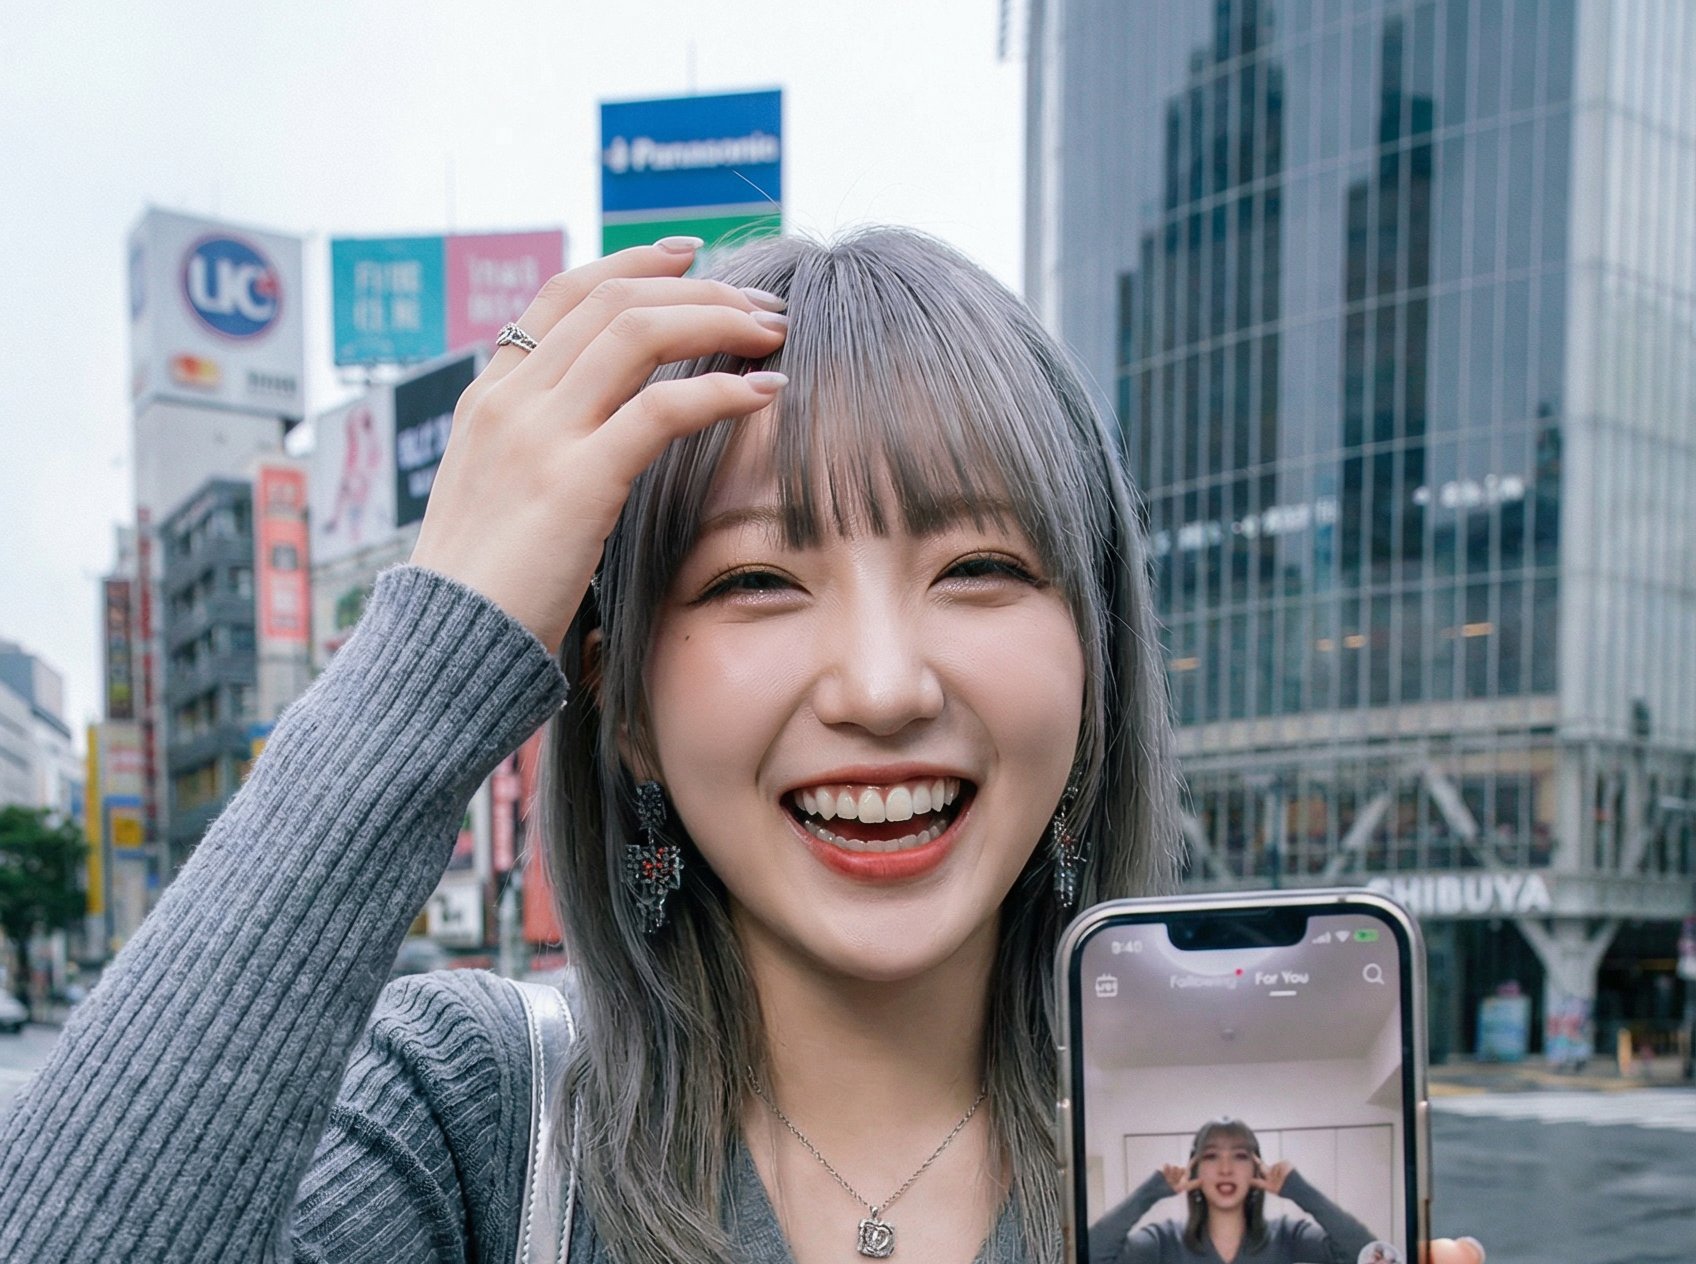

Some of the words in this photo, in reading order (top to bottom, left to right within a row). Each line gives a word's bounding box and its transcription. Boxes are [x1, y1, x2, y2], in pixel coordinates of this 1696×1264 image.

[188, 254, 276, 322] UC
[1255, 972, 1279, 986] For
[1281, 969, 1309, 985] You
